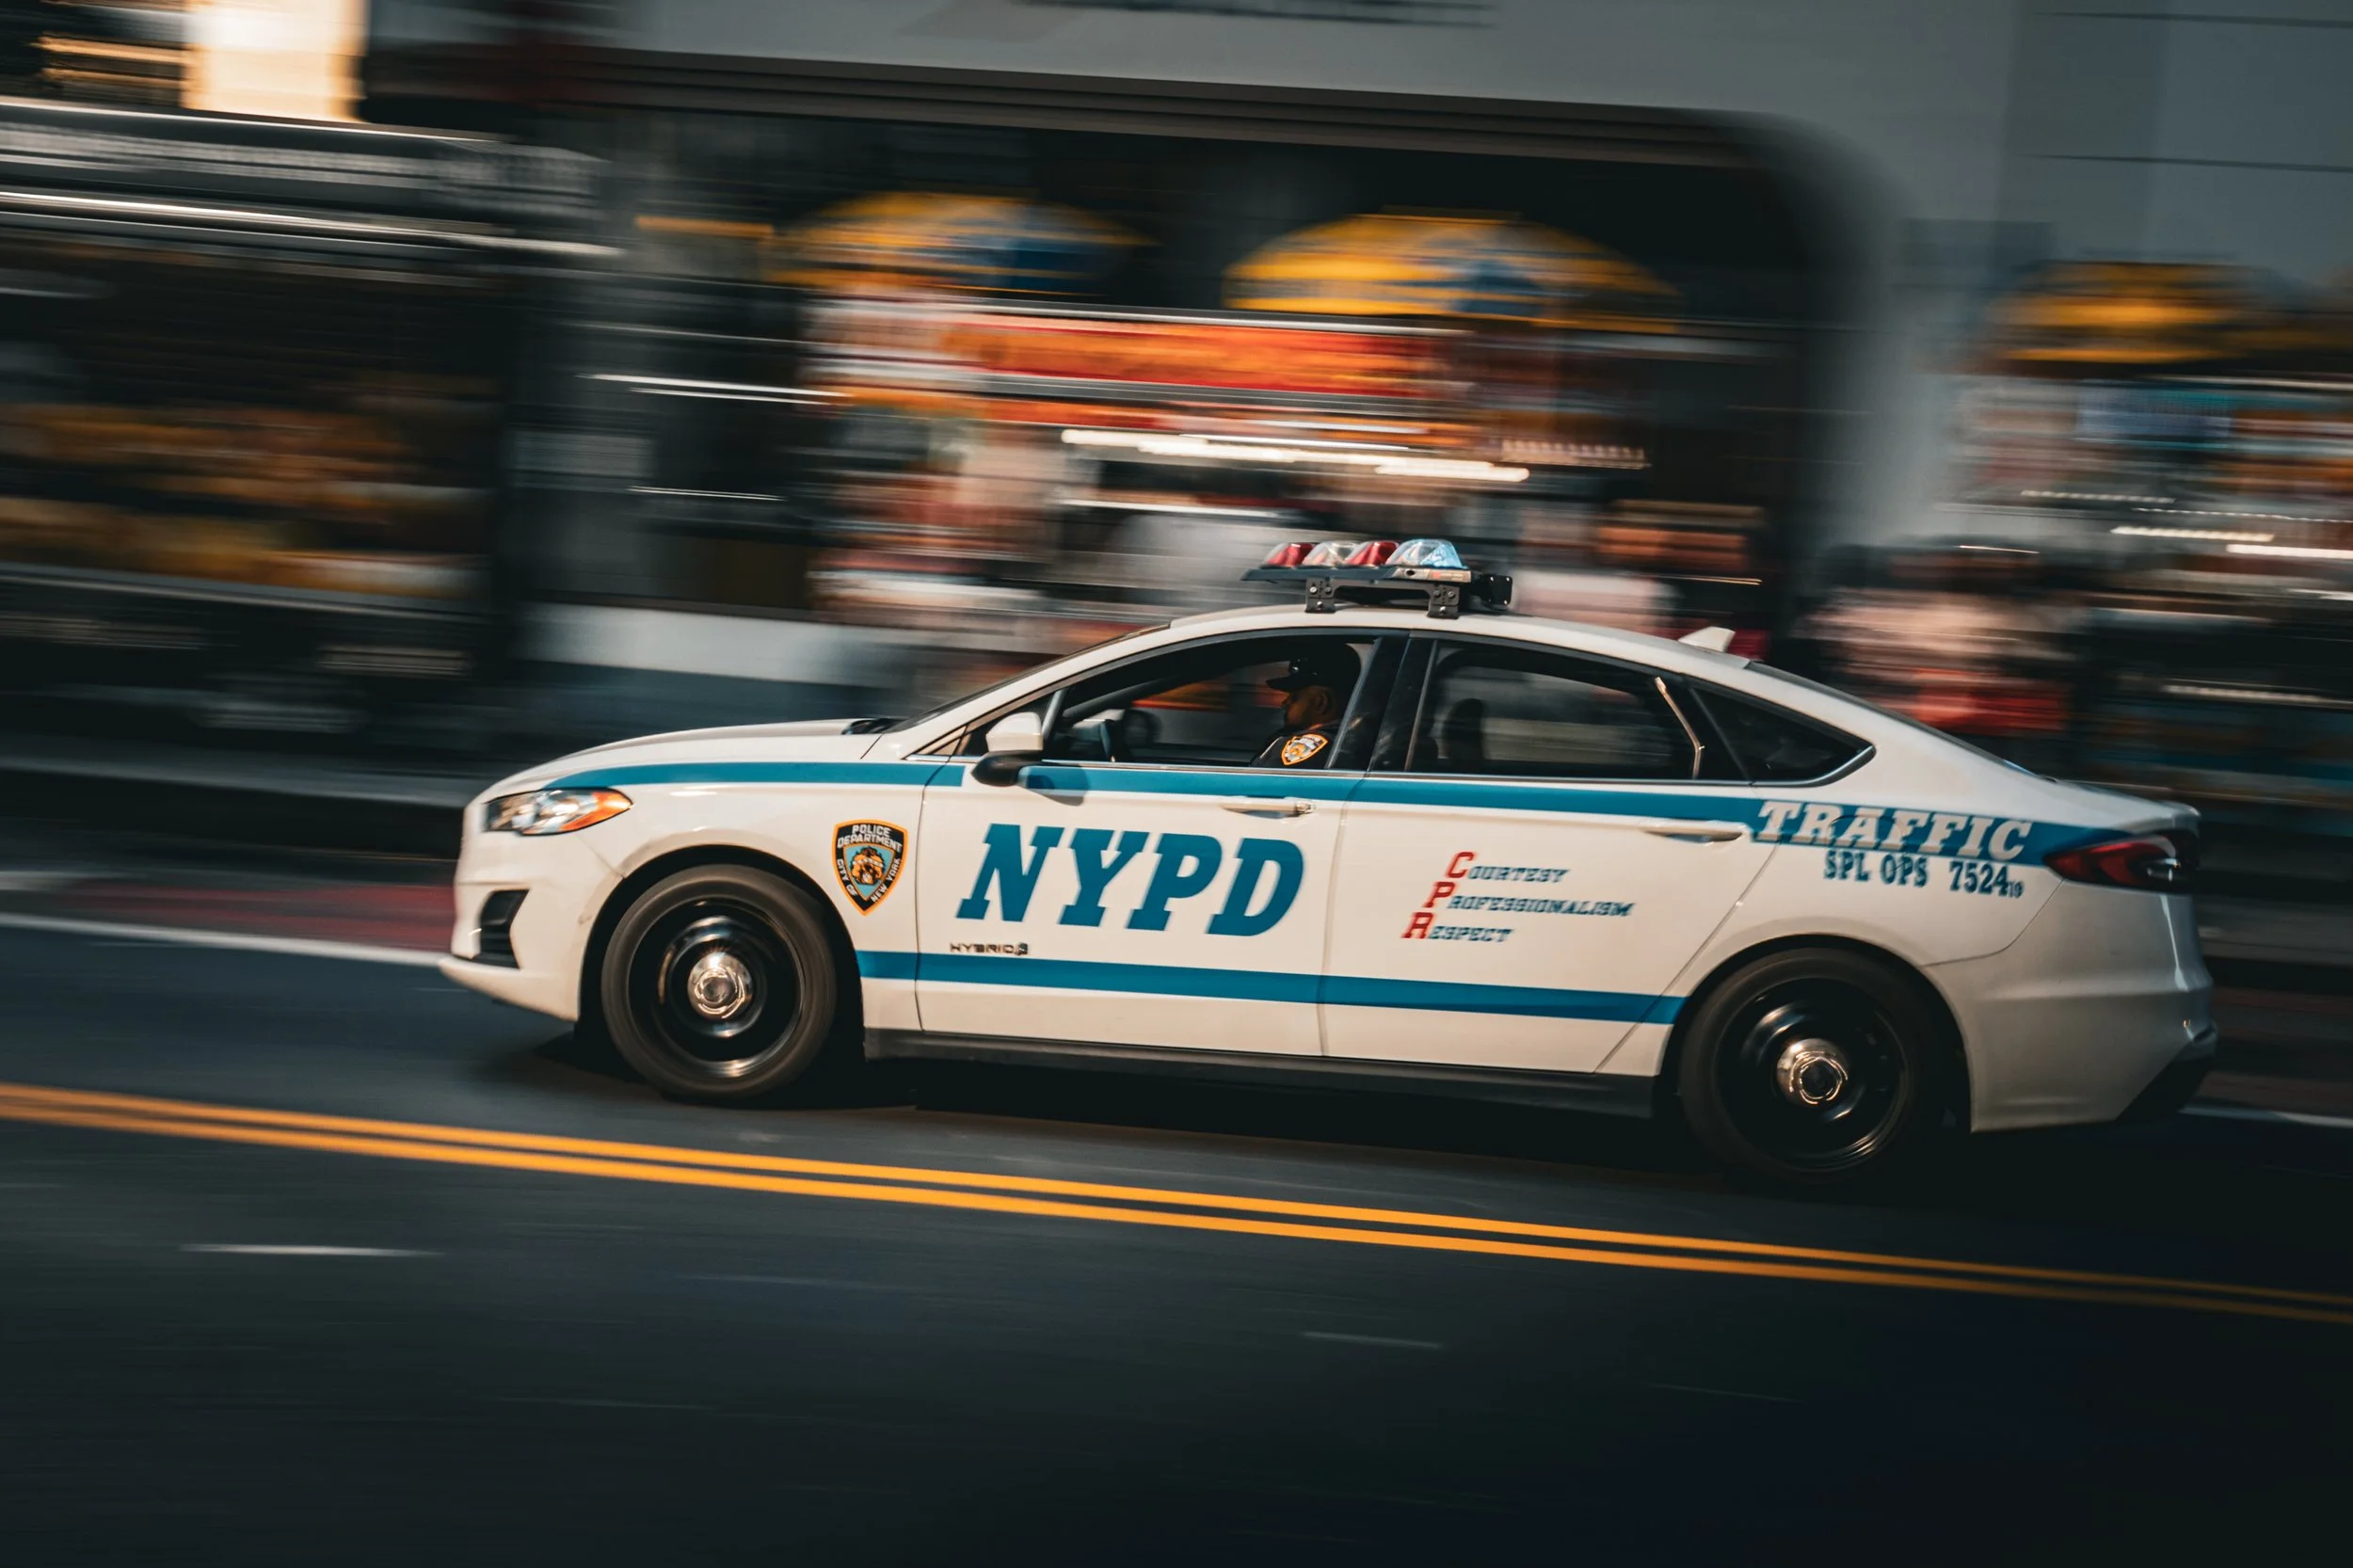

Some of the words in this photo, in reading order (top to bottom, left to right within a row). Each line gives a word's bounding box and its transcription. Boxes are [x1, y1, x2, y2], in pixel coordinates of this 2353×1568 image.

[837, 833, 903, 852] DEPARTMENT
[852, 824, 892, 838] POLICE
[1756, 800, 2034, 861] TRAFFIC
[837, 858, 850, 882] CITY
[846, 884, 858, 896] OF
[870, 884, 888, 903] NEW
[886, 857, 902, 881] YORK
[955, 823, 1305, 937] NYPD
[1446, 851, 1569, 883] COURTESY
[1823, 850, 1869, 882] SPL
[1880, 853, 1929, 888] OPS
[1423, 881, 1635, 916] PROFESSIONALISM
[1401, 911, 1513, 943] RESPECT
[950, 942, 1015, 954] HYBRID
